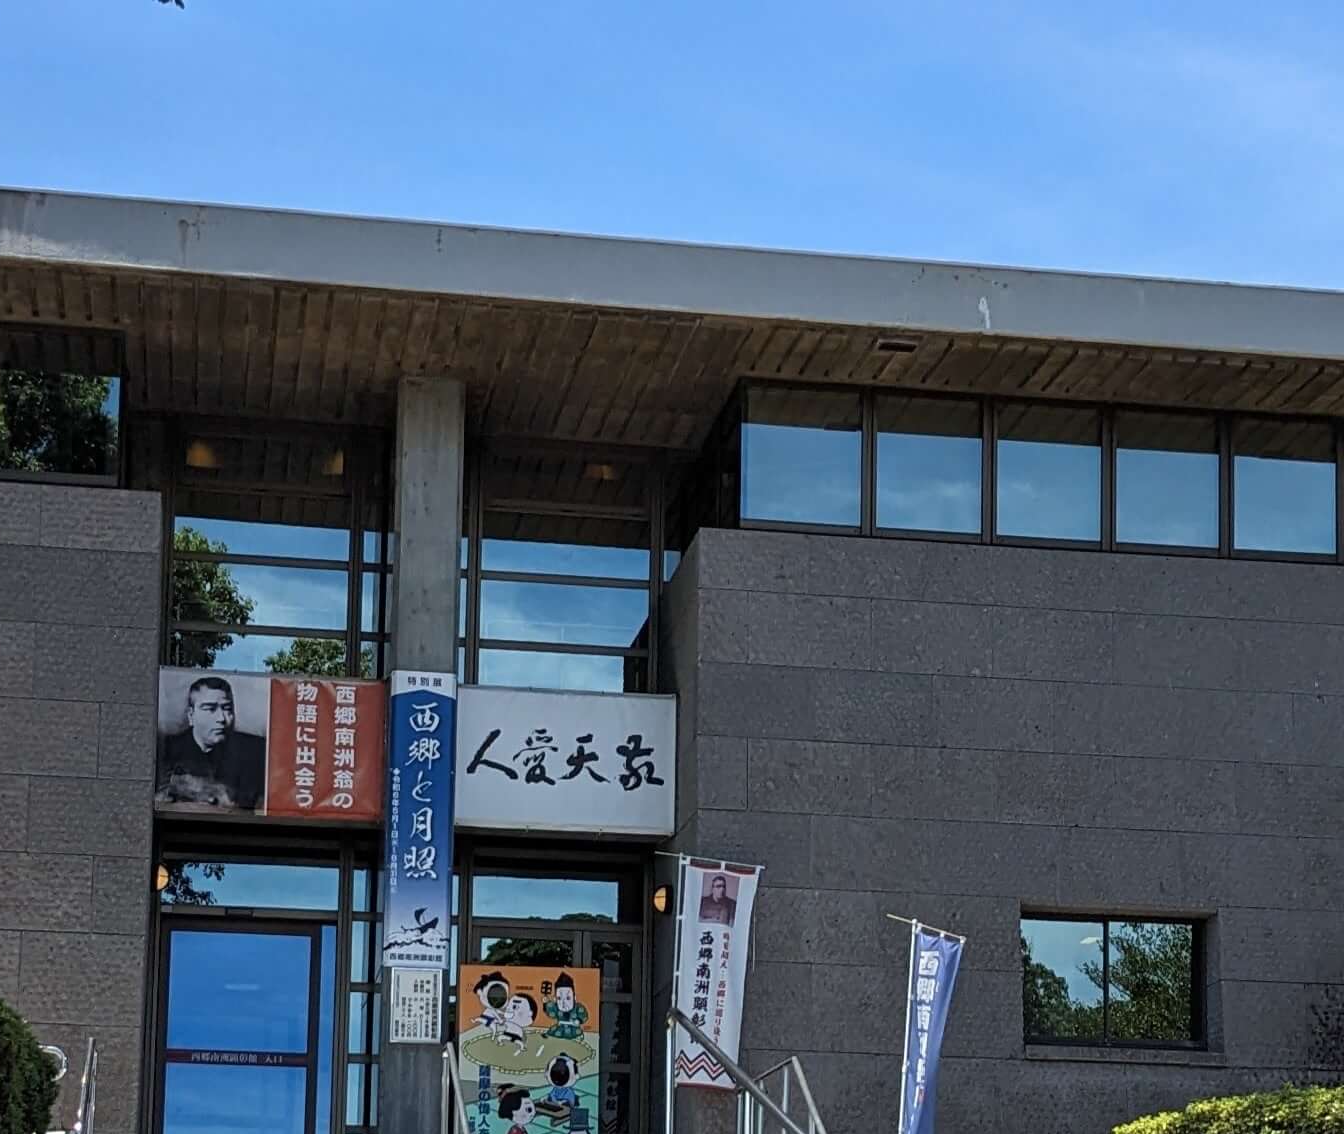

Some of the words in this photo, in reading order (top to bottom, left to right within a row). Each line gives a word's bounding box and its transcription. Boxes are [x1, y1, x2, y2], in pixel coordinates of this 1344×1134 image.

[295, 682, 318, 808] 物語に出会う
[332, 685, 356, 809] 西郷南洲翁の
[404, 701, 440, 879] 西郷と月照
